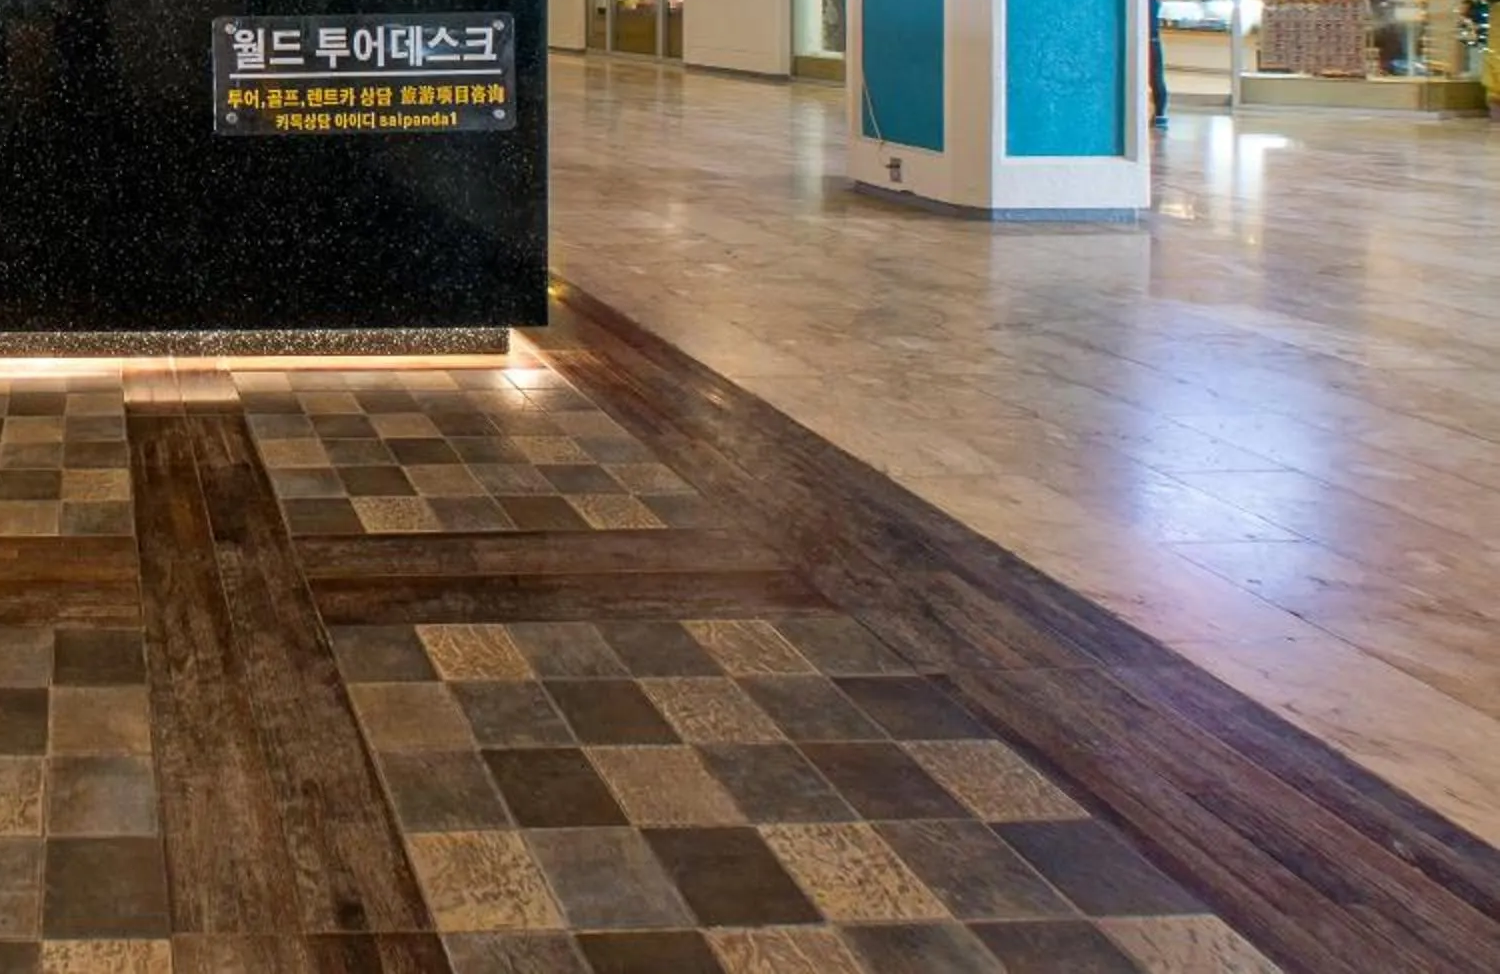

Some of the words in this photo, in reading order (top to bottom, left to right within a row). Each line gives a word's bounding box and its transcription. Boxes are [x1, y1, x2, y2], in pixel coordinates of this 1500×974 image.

[233, 29, 304, 70] 월드
[316, 26, 497, 68] 투어데스크
[360, 86, 392, 107] 상담
[335, 113, 375, 129] 아이디
